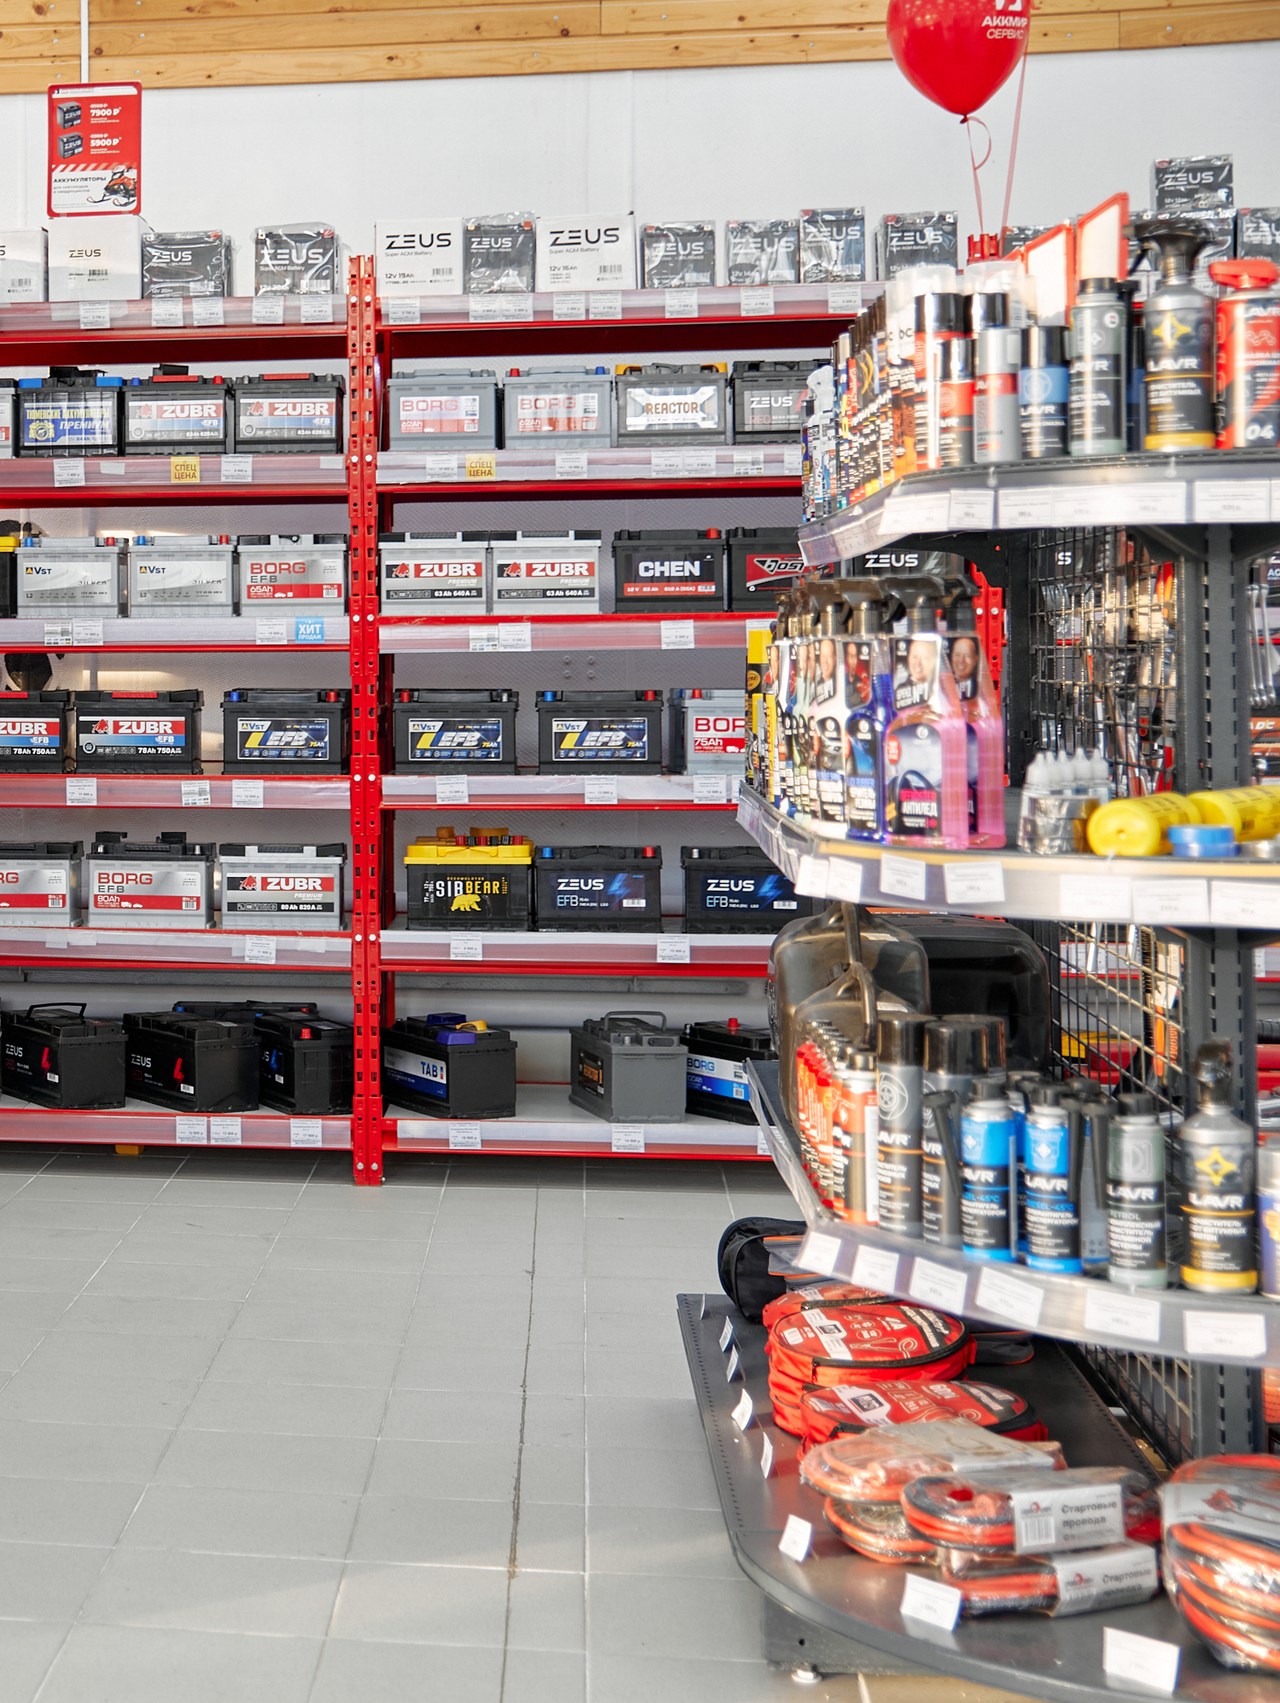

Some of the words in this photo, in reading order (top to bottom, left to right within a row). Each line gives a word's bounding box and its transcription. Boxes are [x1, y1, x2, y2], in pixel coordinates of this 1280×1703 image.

[90, 109, 112, 117] 7900
[90, 139, 111, 147] 5900
[1164, 171, 1214, 186] ZEUS
[549, 228, 619, 247] ZEUS
[805, 226, 861, 241] ZEUS
[890, 229, 942, 245] ZEUS
[386, 233, 451, 250] ZEUS
[471, 237, 512, 248] ZEUS
[732, 237, 795, 253] ZEUS
[69, 249, 101, 258] ZEUS
[652, 242, 704, 256] ZEUS
[151, 251, 192, 262] ZEUS
[260, 249, 323, 265] ZEUS
[1149, 357, 1199, 372] LAVR
[402, 400, 458, 411] BORG
[520, 397, 576, 410] BORG
[646, 402, 699, 415] REACTOR
[750, 396, 793, 408] ZEUS
[162, 404, 216, 418] ZUBR
[273, 402, 329, 416] ZUBR
[1246, 424, 1274, 440] 04
[174, 463, 197, 473] СПЕЦ
[469, 460, 493, 469] СПЕЦ
[174, 472, 197, 480] ЦЕНА
[469, 469, 493, 477] ЦЕНА
[865, 554, 918, 567] ZEUS
[250, 562, 306, 574] BORG
[420, 564, 476, 577] ZUBR
[532, 563, 588, 576] ZUBR
[639, 561, 700, 577] CHEN
[250, 575, 278, 583] EFB
[299, 624, 321, 635] ХИТ
[118, 722, 173, 734] ZUBR
[266, 732, 309, 745] EFB
[438, 732, 478, 747] EFB
[582, 732, 626, 746] EFB
[695, 738, 723, 746] 75Ah
[98, 872, 153, 885] BORG
[267, 878, 322, 890] ZUBR
[557, 879, 604, 891] ZEUS
[98, 885, 125, 893] EFB
[435, 880, 500, 898] SIBBEAR
[707, 880, 754, 892] ZEUS
[557, 895, 578, 907] EFB
[706, 896, 728, 907] EFB
[5, 1044, 24, 1057] ZEUS
[131, 1054, 152, 1068] ZEUS
[687, 1057, 716, 1072] BORG
[421, 1060, 439, 1078] TAB
[1024, 1175, 1068, 1191] LAVR
[1107, 1184, 1156, 1200] LAVR
[1188, 1192, 1245, 1209] LAVR
[1061, 1500, 1118, 1515] Стартовые
[1062, 1516, 1106, 1528] провода
[1102, 1567, 1153, 1584] Стартовые
